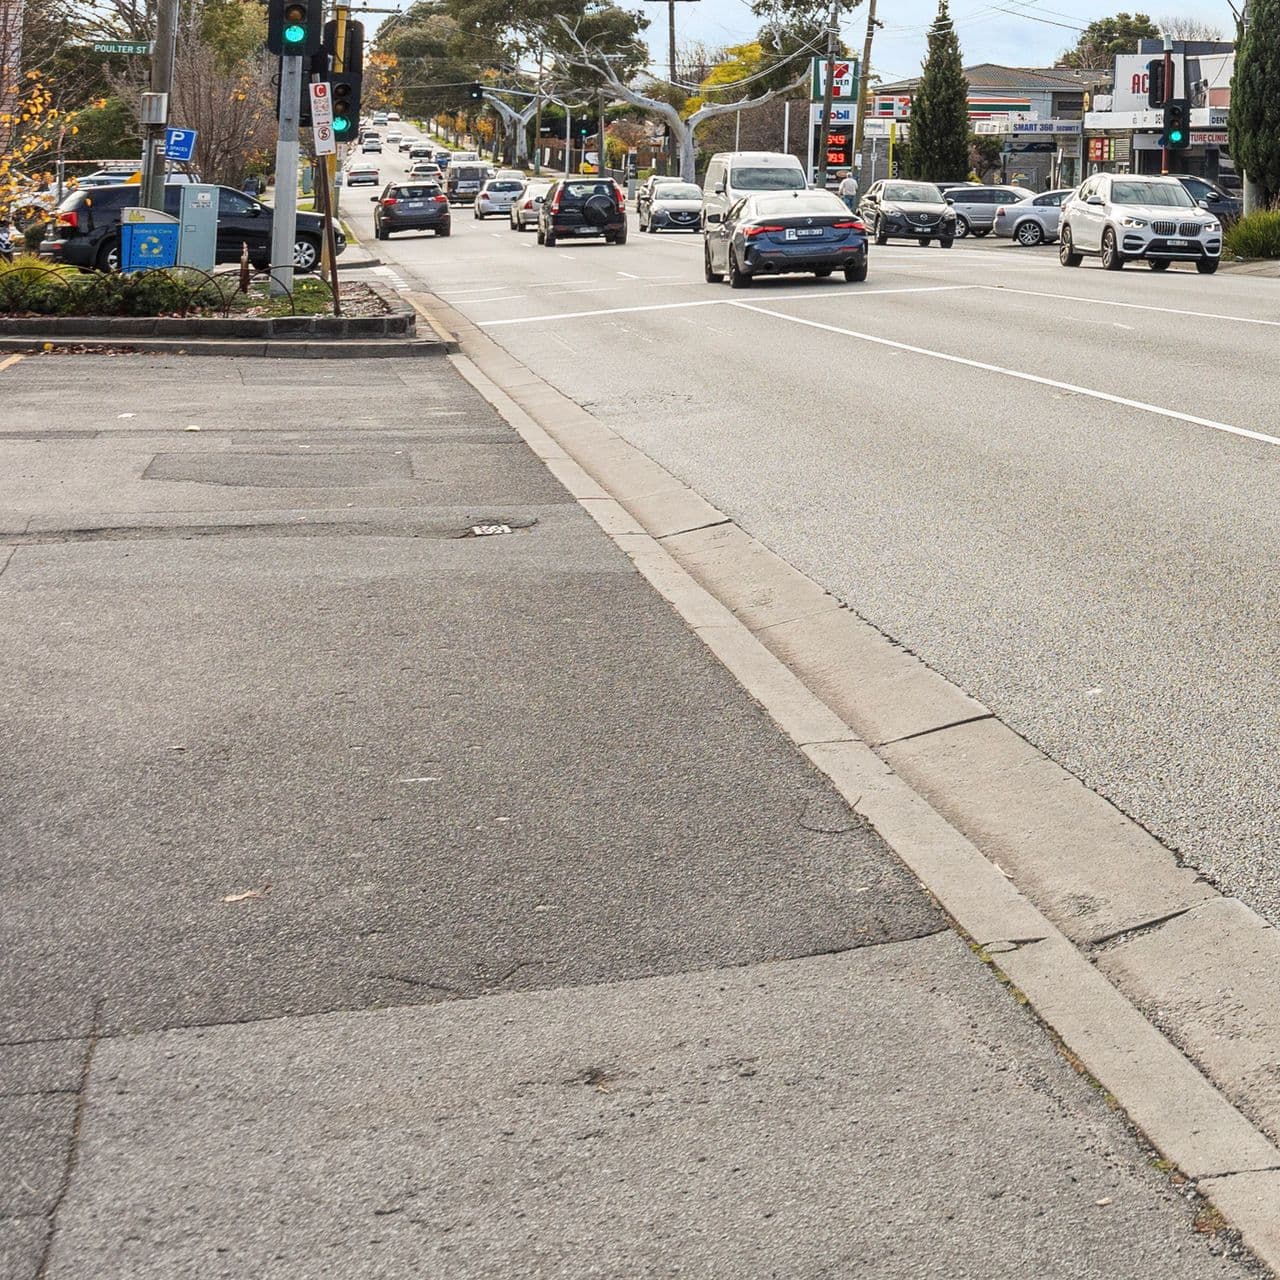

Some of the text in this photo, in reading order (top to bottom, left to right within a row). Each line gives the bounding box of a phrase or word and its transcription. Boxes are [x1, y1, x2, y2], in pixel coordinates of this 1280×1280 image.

[94, 43, 147, 54] POULTER ST
[1013, 123, 1038, 132] SMART
[1039, 123, 1054, 132] 360
[170, 131, 185, 145] P
[1207, 133, 1228, 142] CLINIC
